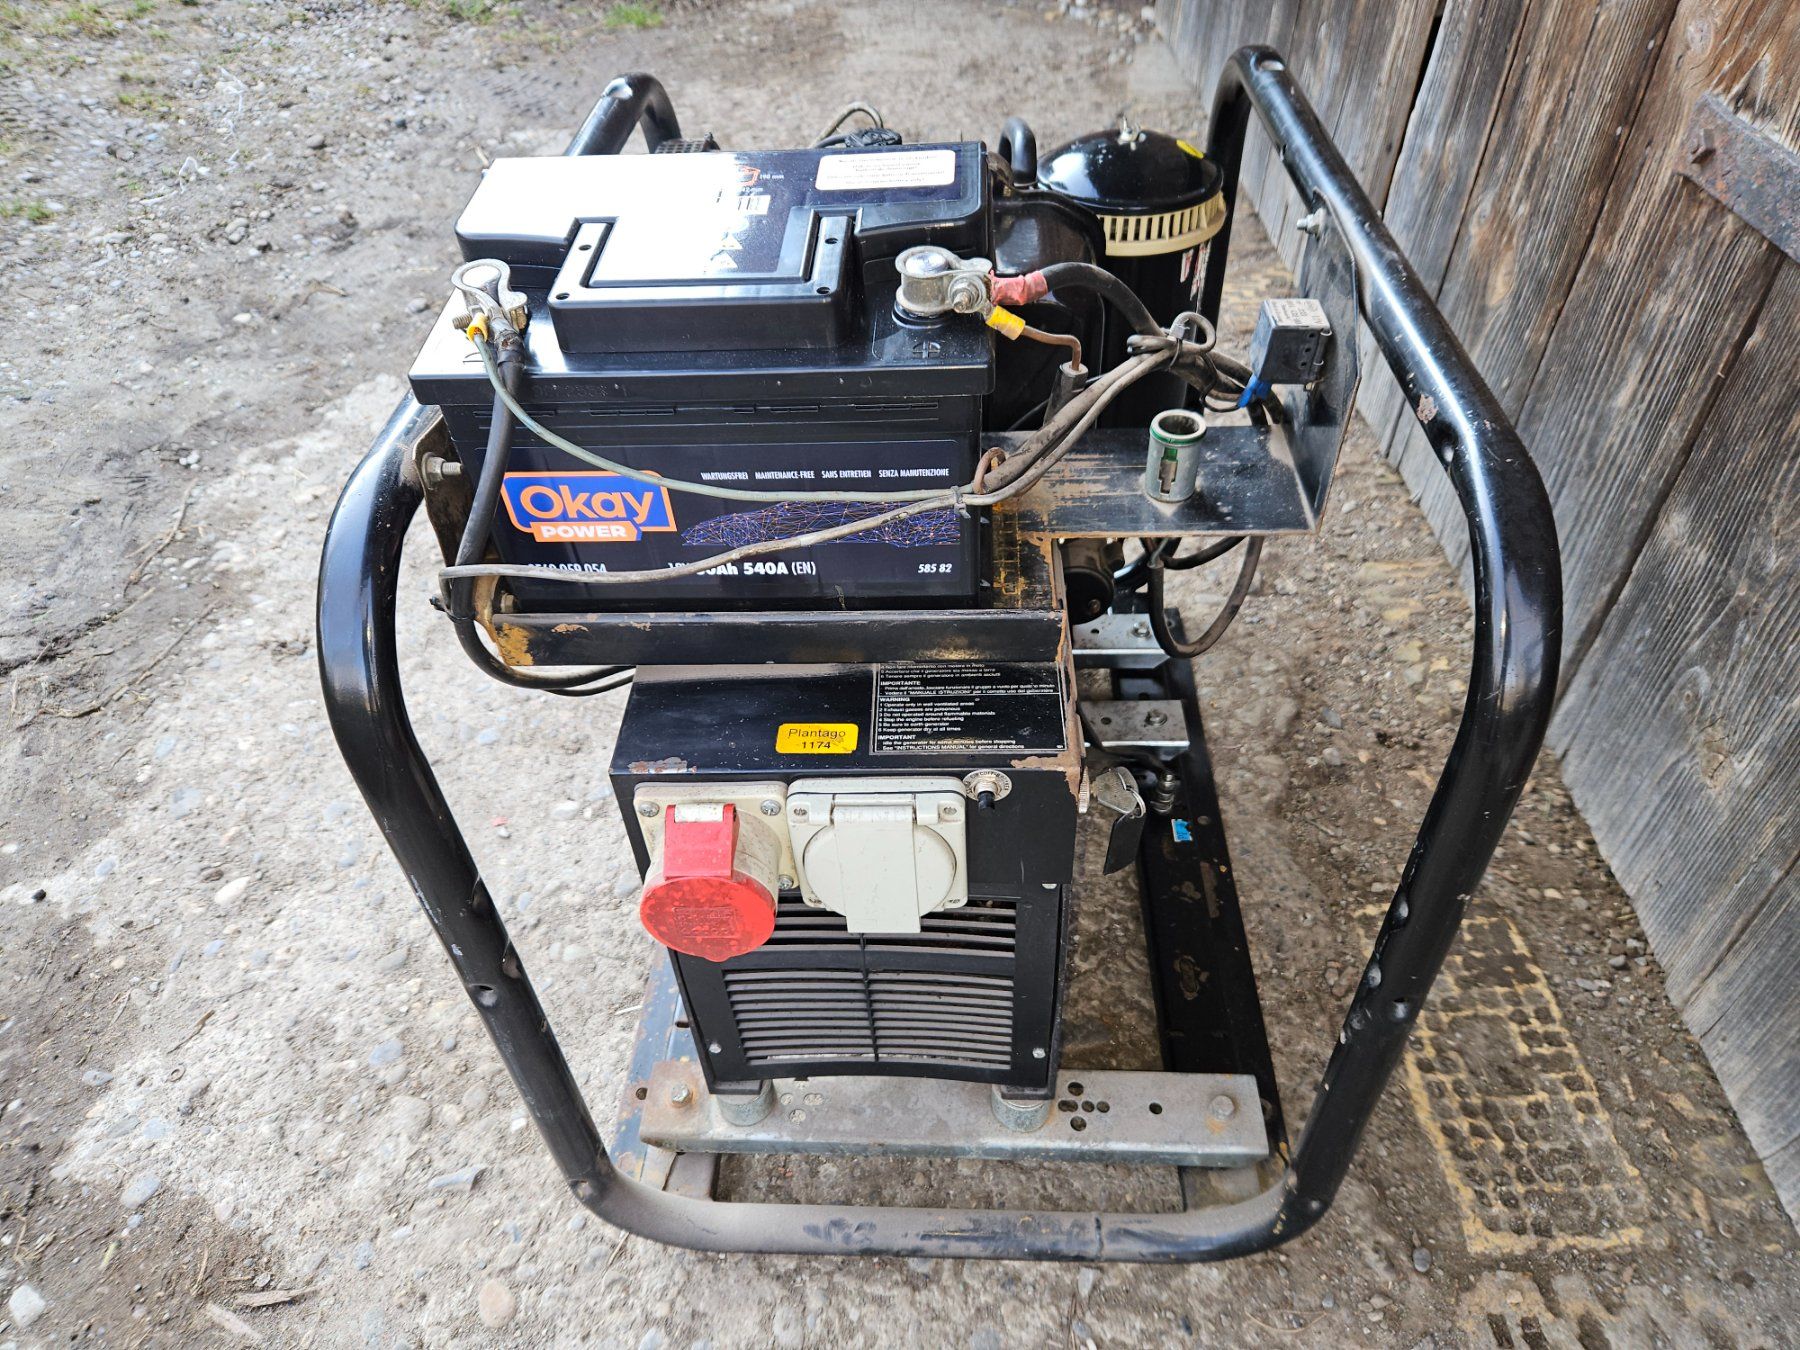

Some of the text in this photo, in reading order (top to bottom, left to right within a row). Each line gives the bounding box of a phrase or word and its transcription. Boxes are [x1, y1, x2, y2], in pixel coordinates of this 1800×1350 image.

[701, 468, 950, 480] WARTUNGSFREI MAINTENANCE-FREE SANS ENTRETIEN SENZA MANUTENZIONE
[520, 485, 654, 525] Okay
[540, 525, 627, 538] POWER
[743, 562, 789, 575] 540A
[791, 561, 817, 576] (EN)
[939, 563, 953, 573] 82
[788, 728, 846, 740] Plantago
[802, 741, 831, 749] 1174
